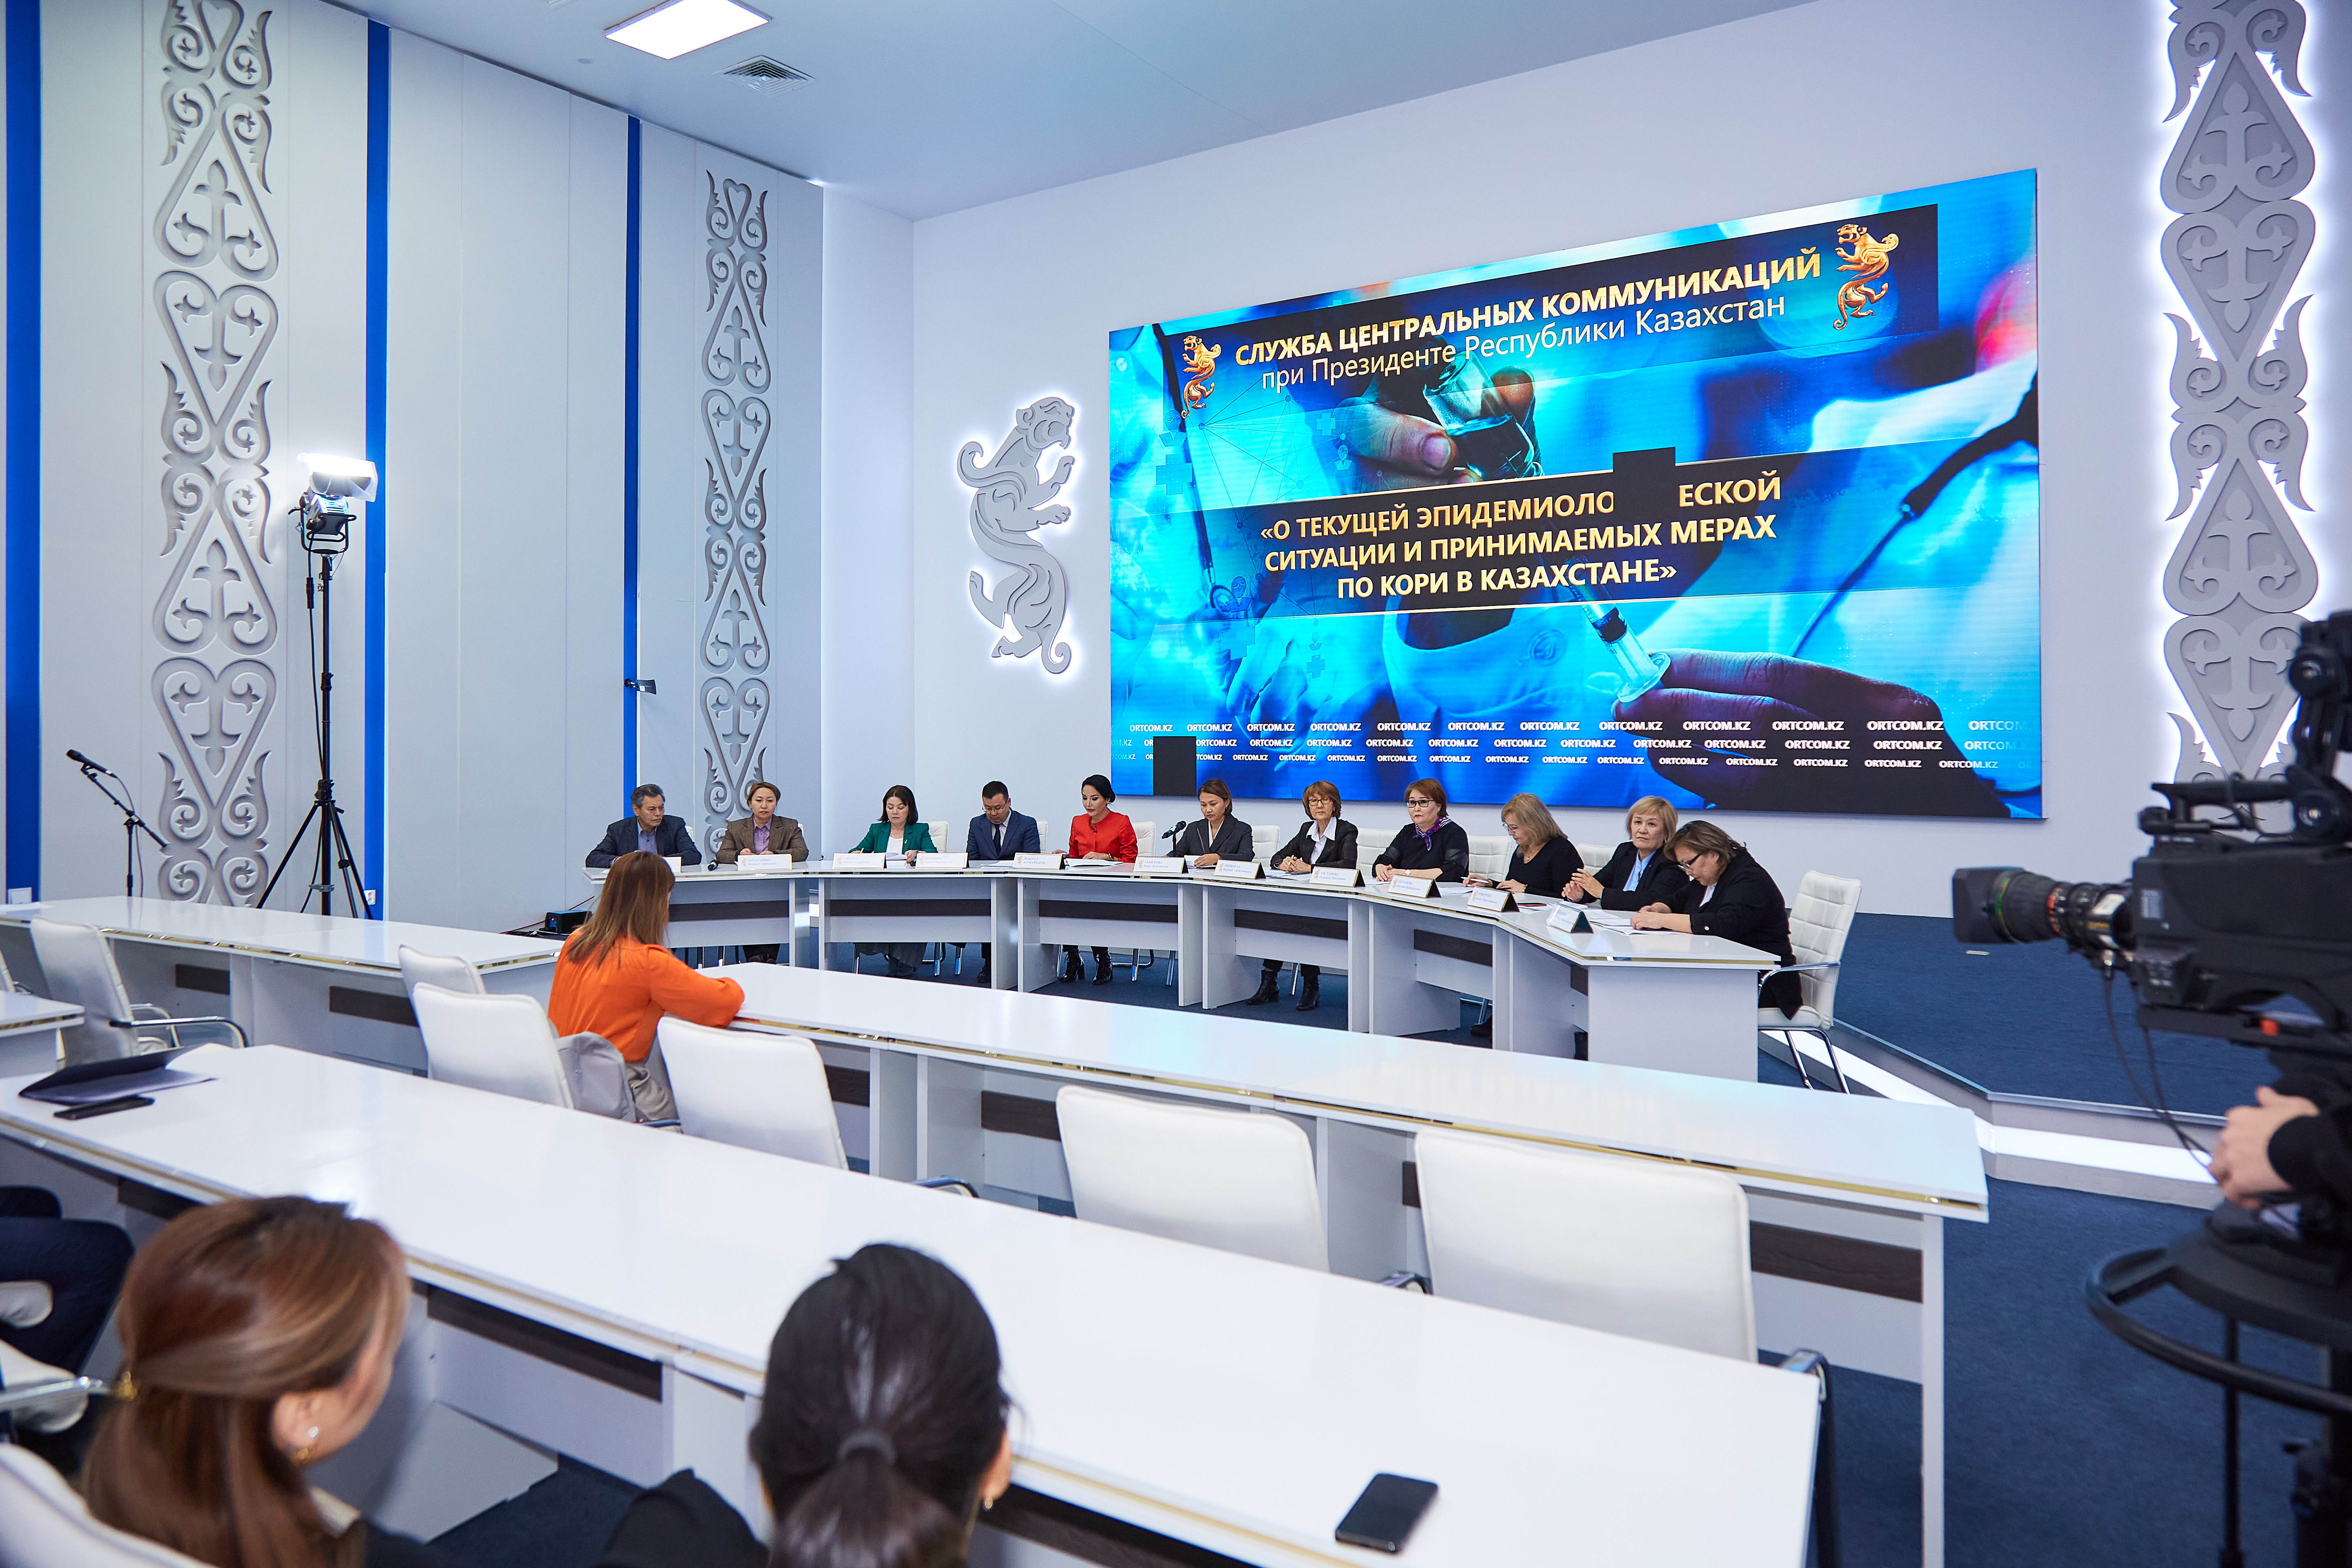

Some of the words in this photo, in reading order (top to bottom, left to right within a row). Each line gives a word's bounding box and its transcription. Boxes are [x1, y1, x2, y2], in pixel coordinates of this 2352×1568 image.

[1235, 331, 1333, 365] СЛУЖБА
[1339, 298, 1535, 353] ЦЕНТРАЛЬНЫХ
[1542, 246, 1821, 318] КОММУНИКАЦИЙ
[1262, 367, 1304, 394] при
[1312, 344, 1456, 386] Президенте
[1466, 319, 1625, 359] Республики
[1636, 296, 1785, 335] Казахстан
[1261, 520, 1290, 540] «О
[1296, 503, 1409, 538] ТЕКУЩЕЙ
[1265, 542, 1396, 571] СИТУАЦИИ
[1403, 541, 1422, 562] И
[1430, 523, 1662, 560] ПРИНИМАЕМЫХ
[1670, 514, 1777, 544] МЕРАХ
[1338, 577, 1374, 599] ПО
[1381, 572, 1448, 597] КОРИ
[1457, 571, 1473, 592] В
[1481, 559, 1677, 591] КАЗАХСТАНЕ»
[1187, 724, 1233, 732] ORTCOM.KZ
[1247, 723, 1295, 732] ORTCOM.KZ
[1310, 723, 1361, 731] ORTCOM.KZ
[1377, 722, 1431, 731] ORTCOM.KZ
[1448, 722, 1505, 731] ORTCOM.KZ
[1520, 722, 1580, 731] ORTCOM.KZ
[1599, 721, 1663, 731] ORTCOM.KZ
[1683, 721, 1751, 731] ORTCOM.KZ
[1772, 721, 1844, 731] ORTCOM.KZ
[1867, 721, 1944, 731] ORTCOM.KZ
[1365, 739, 1414, 747] ORTCOM.KZ
[1428, 739, 1479, 747] ORTCOM.KZ
[1494, 739, 1547, 748] ORTCOM.KZ
[1560, 739, 1616, 748] ORTCOM.KZ
[1633, 739, 1692, 748] ORTCOM.KZ
[1704, 739, 1766, 749] ORTCOM.KZ
[1785, 740, 1851, 749] ORTCOM.KZ
[1873, 740, 1943, 750] ORTCOM.KZ
[1659, 757, 1709, 765] ORTCOM.KZ
[1726, 758, 1778, 766] ORTCOM.KZ
[1793, 759, 1848, 767] ORTCOM.KZ
[1864, 759, 1922, 768] ORTCOM.KZ
